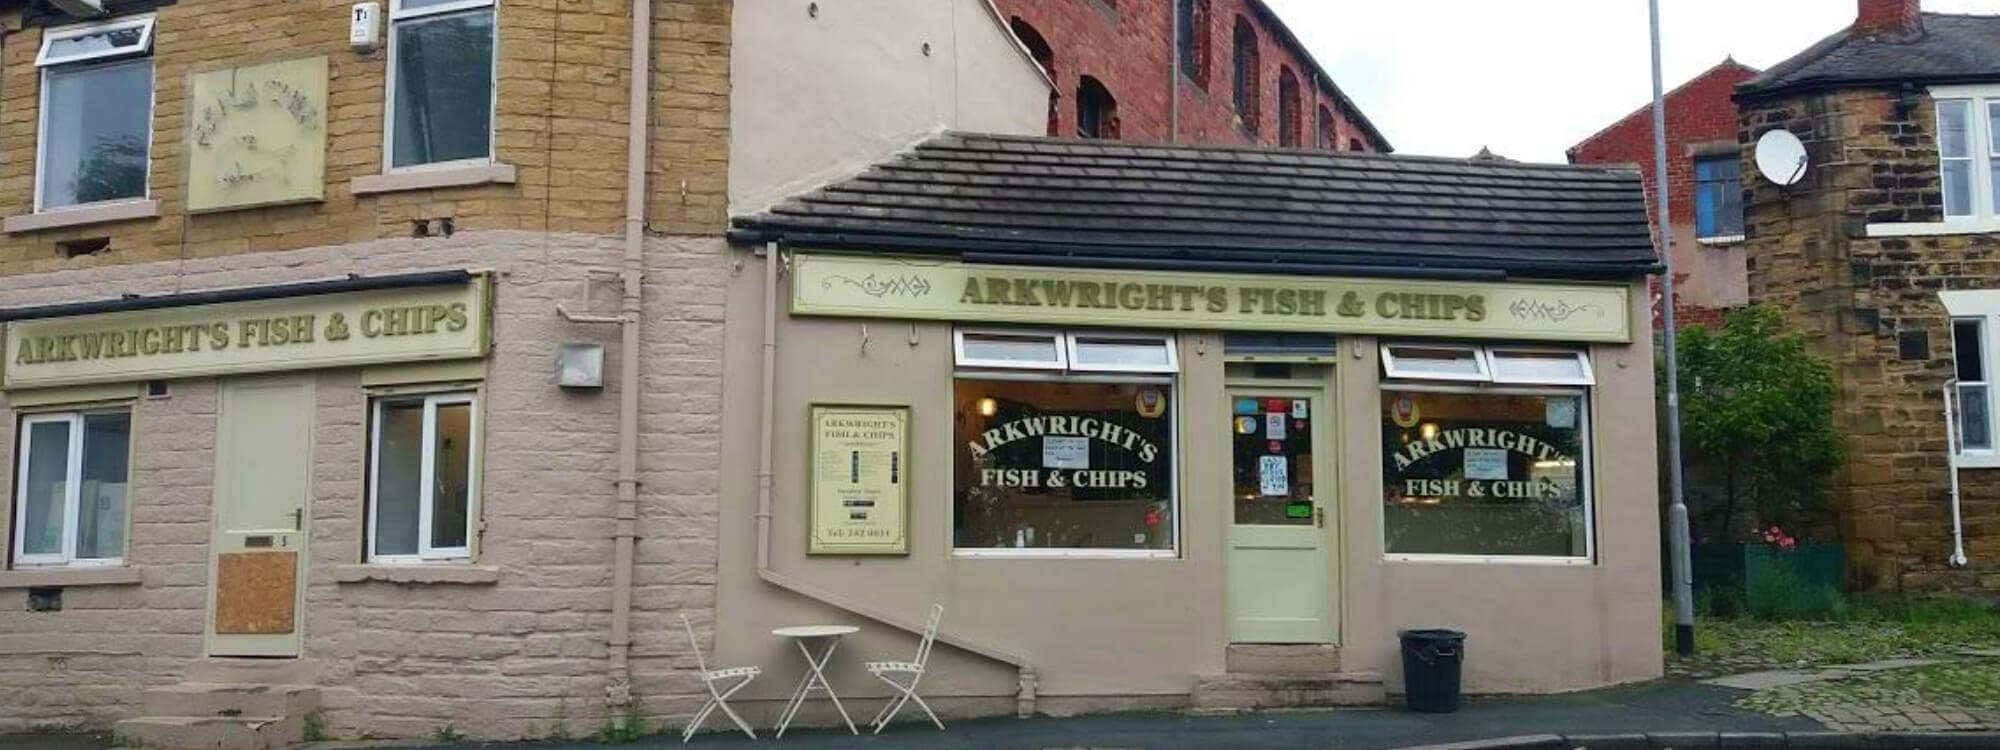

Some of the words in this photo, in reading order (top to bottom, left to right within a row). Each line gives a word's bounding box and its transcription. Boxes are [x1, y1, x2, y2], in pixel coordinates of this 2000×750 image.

[960, 277, 1228, 313] ARKWRIGHT'S
[1239, 287, 1327, 317] FISH
[1336, 290, 1365, 318] &
[1375, 292, 1487, 322] CHIPS
[16, 322, 230, 366] ARKWRIGHT'S
[237, 315, 315, 348] FISH
[324, 311, 349, 341] &
[360, 303, 468, 338] CHIPS
[968, 415, 1159, 463] ARKWRIGHT'S
[980, 468, 1040, 488] FISH
[1046, 469, 1065, 488] &
[1072, 469, 1148, 489] CHIPS
[1406, 480, 1460, 497] FISH
[1467, 480, 1486, 498] &
[1491, 480, 1562, 499] CHIPS
